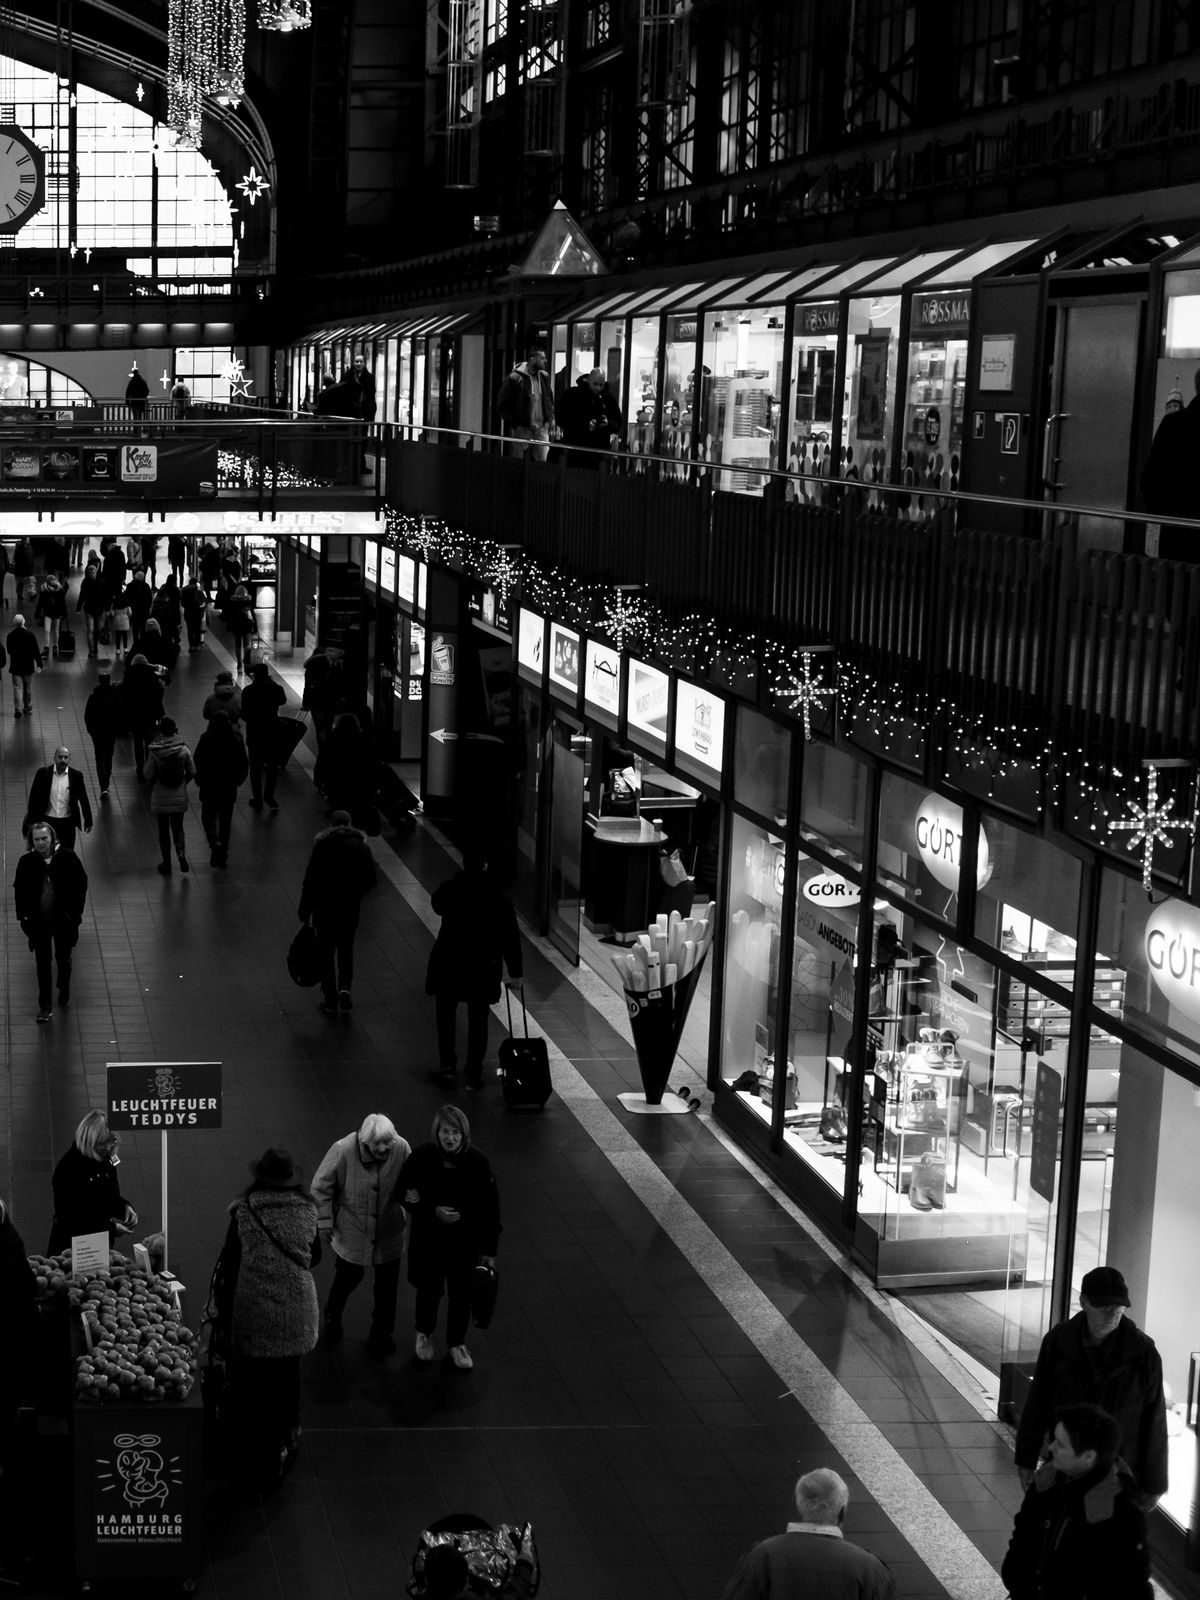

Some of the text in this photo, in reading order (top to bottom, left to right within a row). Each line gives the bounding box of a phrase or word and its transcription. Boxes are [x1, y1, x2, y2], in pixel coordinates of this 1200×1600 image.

[112, 1098, 217, 1112] LEUCHTFEUER
[130, 1113, 198, 1126] TEDDYS
[96, 1514, 182, 1524] HAMBURG
[96, 1526, 182, 1535] LEUCHTFEUER
